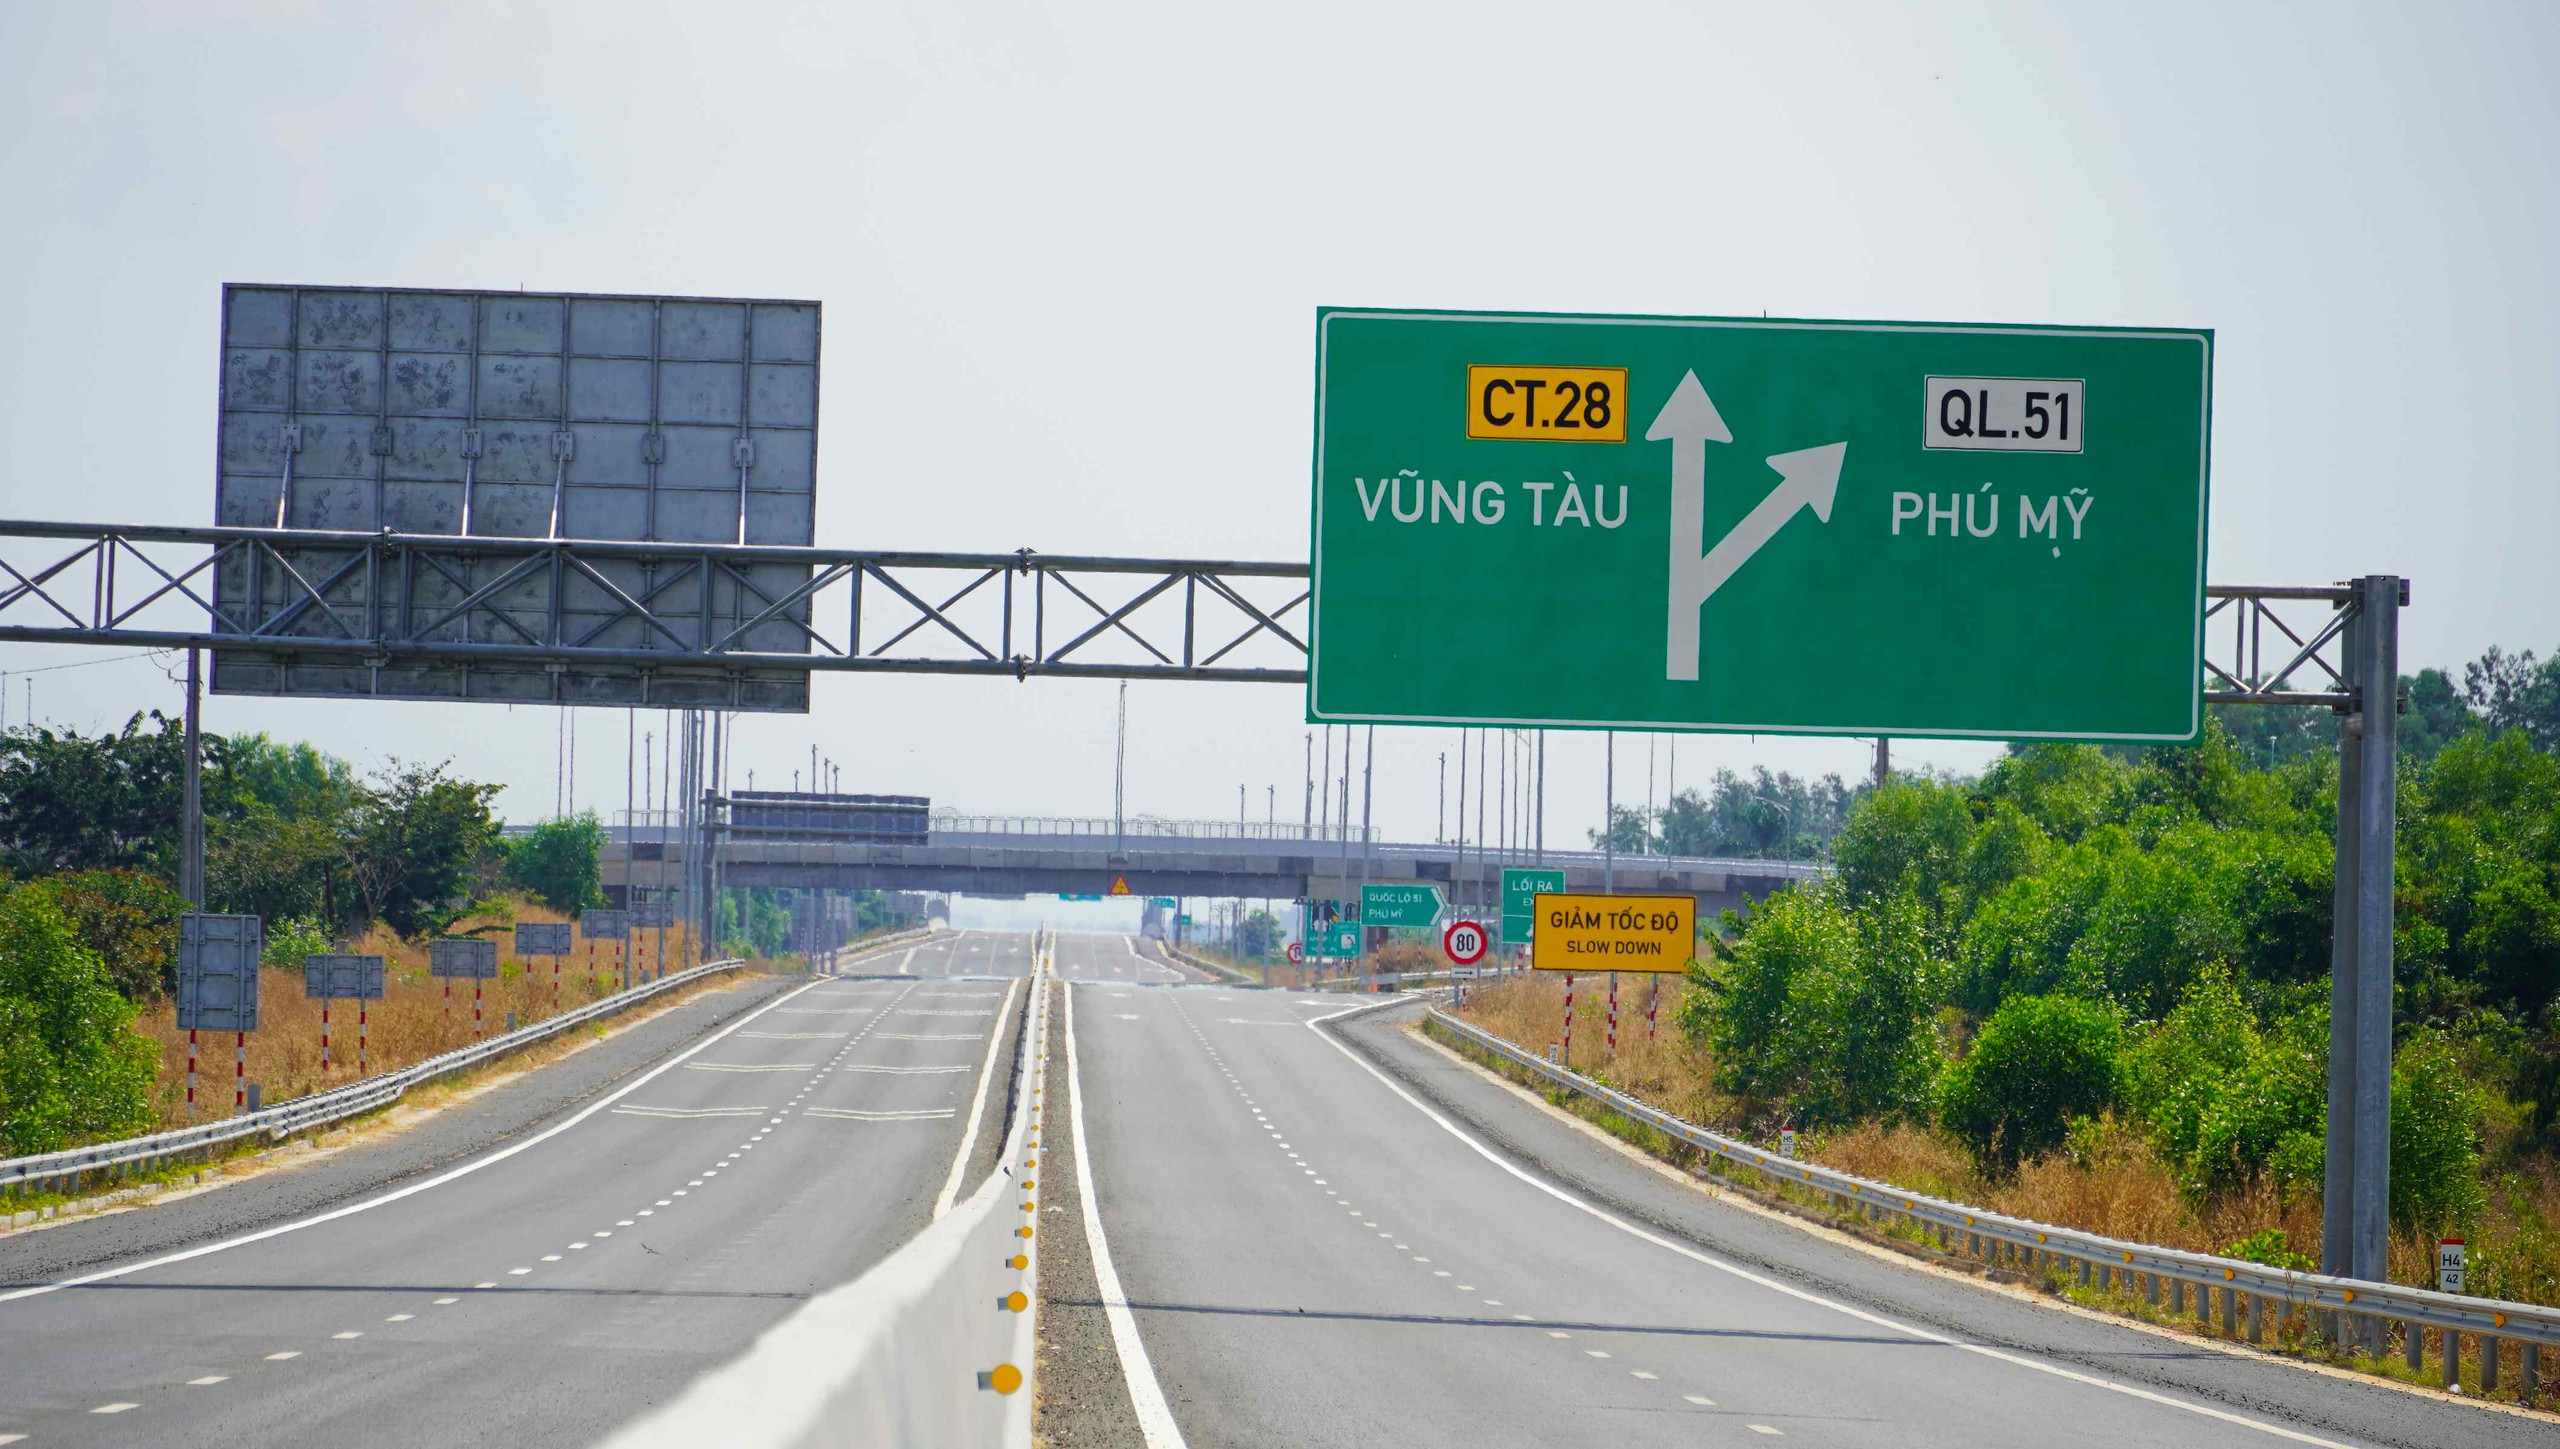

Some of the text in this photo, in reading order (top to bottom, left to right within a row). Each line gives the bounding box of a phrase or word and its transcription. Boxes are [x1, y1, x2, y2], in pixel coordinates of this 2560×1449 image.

[1482, 378, 1611, 430] CT.28
[1940, 388, 2069, 441] QL.51
[1354, 468, 1629, 529] VŨNG TÀU
[1892, 482, 1999, 538] PHÚ
[1512, 876, 1554, 892] LỐI RA
[1369, 891, 1396, 903] QUỐC
[1412, 893, 1422, 903] 51
[1550, 906, 1679, 935] GIẢM TỐC ĐỘ
[1456, 933, 1475, 952] 80
[1566, 940, 1662, 956] SLOW DOWN
[2442, 1253, 2461, 1267] H4
[2445, 1274, 2459, 1284] 42
